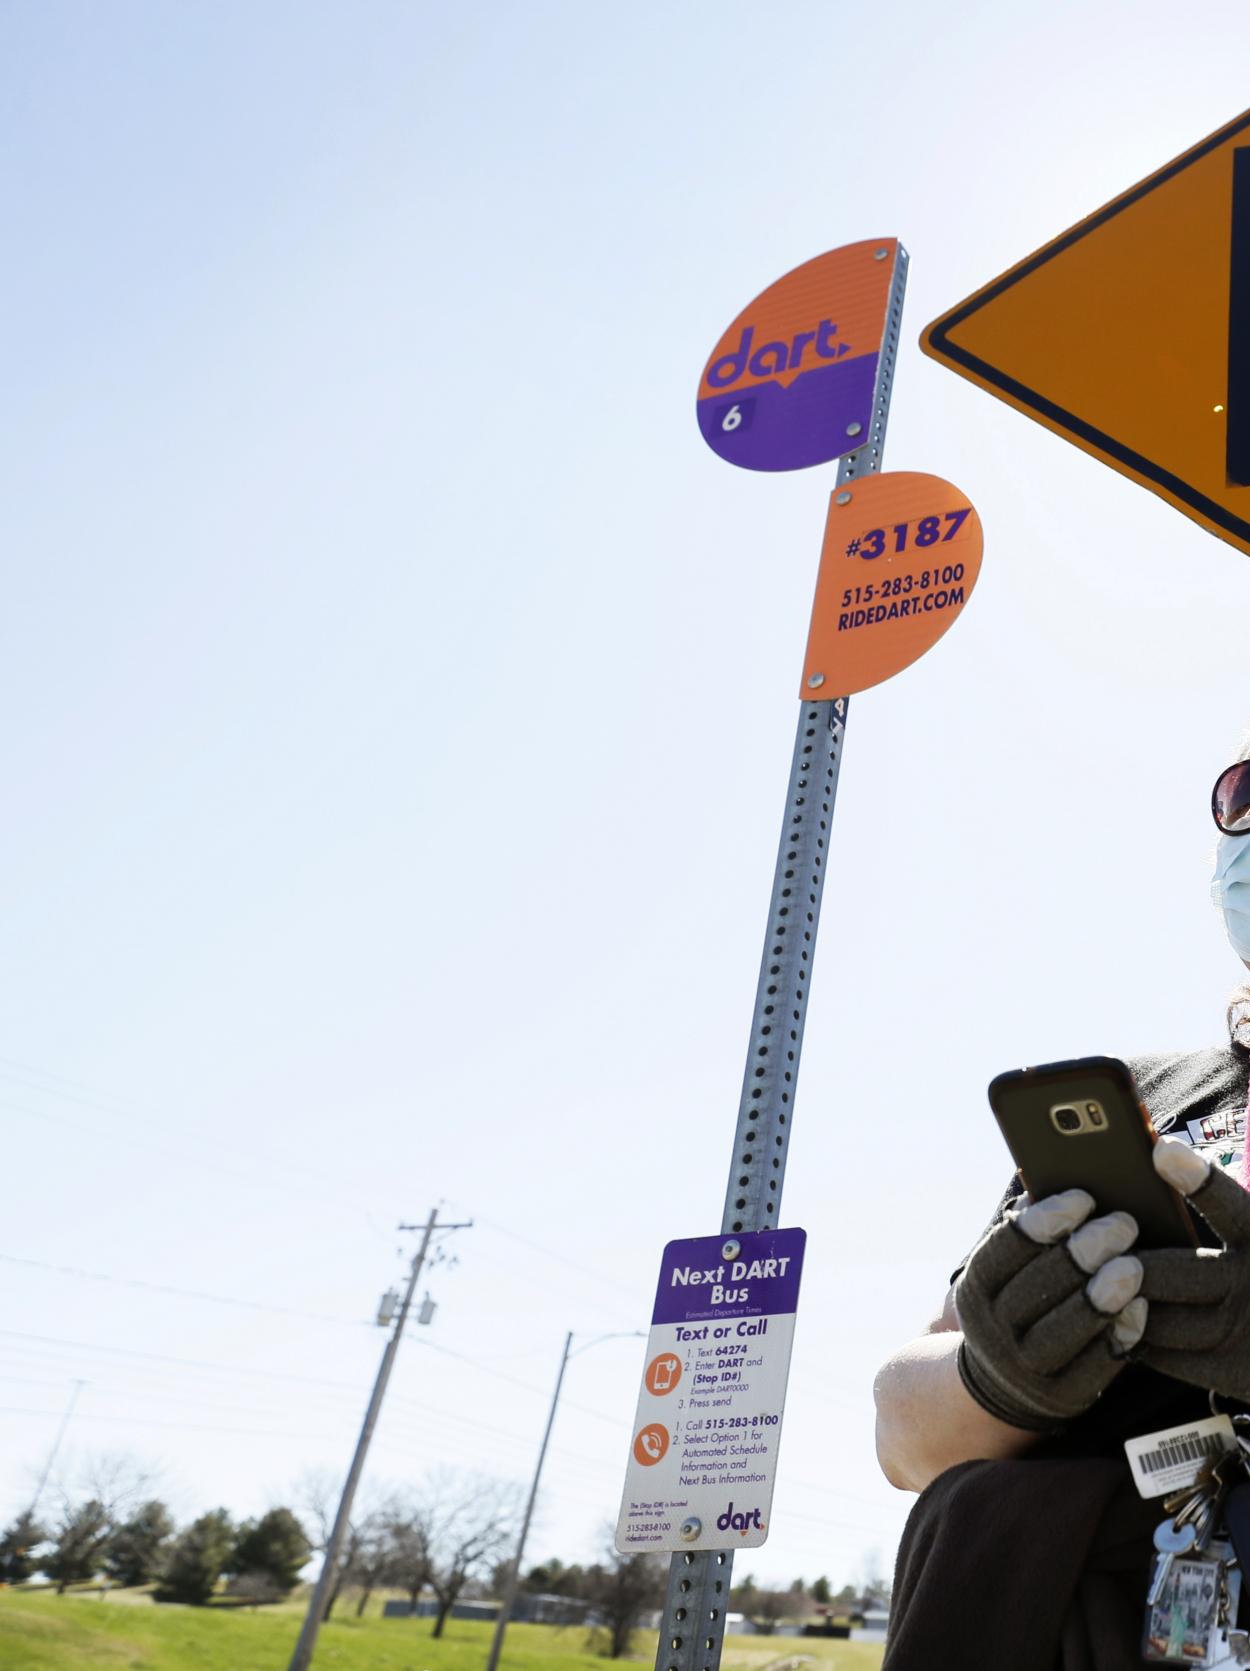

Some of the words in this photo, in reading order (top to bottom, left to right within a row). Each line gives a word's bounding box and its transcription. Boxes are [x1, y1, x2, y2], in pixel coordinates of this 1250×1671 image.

[722, 405, 742, 432] 6
[846, 508, 972, 560] #3187
[841, 563, 965, 608] 515-283-8100
[838, 586, 965, 631] RIDEDART.COM
[671, 1266, 725, 1287] Next
[731, 1257, 790, 1281] DART
[710, 1285, 749, 1304] Bus
[675, 1326, 709, 1342] Text
[713, 1327, 731, 1339] or
[736, 1318, 768, 1337] Call
[698, 1348, 713, 1357] Text
[715, 1344, 748, 1356] 64274
[695, 1360, 716, 1371] Enter
[718, 1357, 745, 1369] DART
[746, 1355, 763, 1367] and
[692, 1374, 718, 1386] (Stop
[721, 1370, 742, 1382] ID#)
[689, 1398, 710, 1408] Press
[712, 1395, 732, 1406] send
[685, 1419, 703, 1431] Call
[705, 1415, 779, 1430] 515-283-8100
[683, 1432, 709, 1445] Select
[710, 1431, 740, 1444] Option
[742, 1430, 748, 1441] 1
[751, 1429, 763, 1441] for
[681, 1445, 728, 1458] Automated
[729, 1442, 768, 1455] Schedule
[681, 1459, 728, 1472] Information
[730, 1458, 748, 1469] and
[679, 1475, 700, 1487] Next
[701, 1474, 716, 1485] Bus
[718, 1472, 767, 1484] Information
